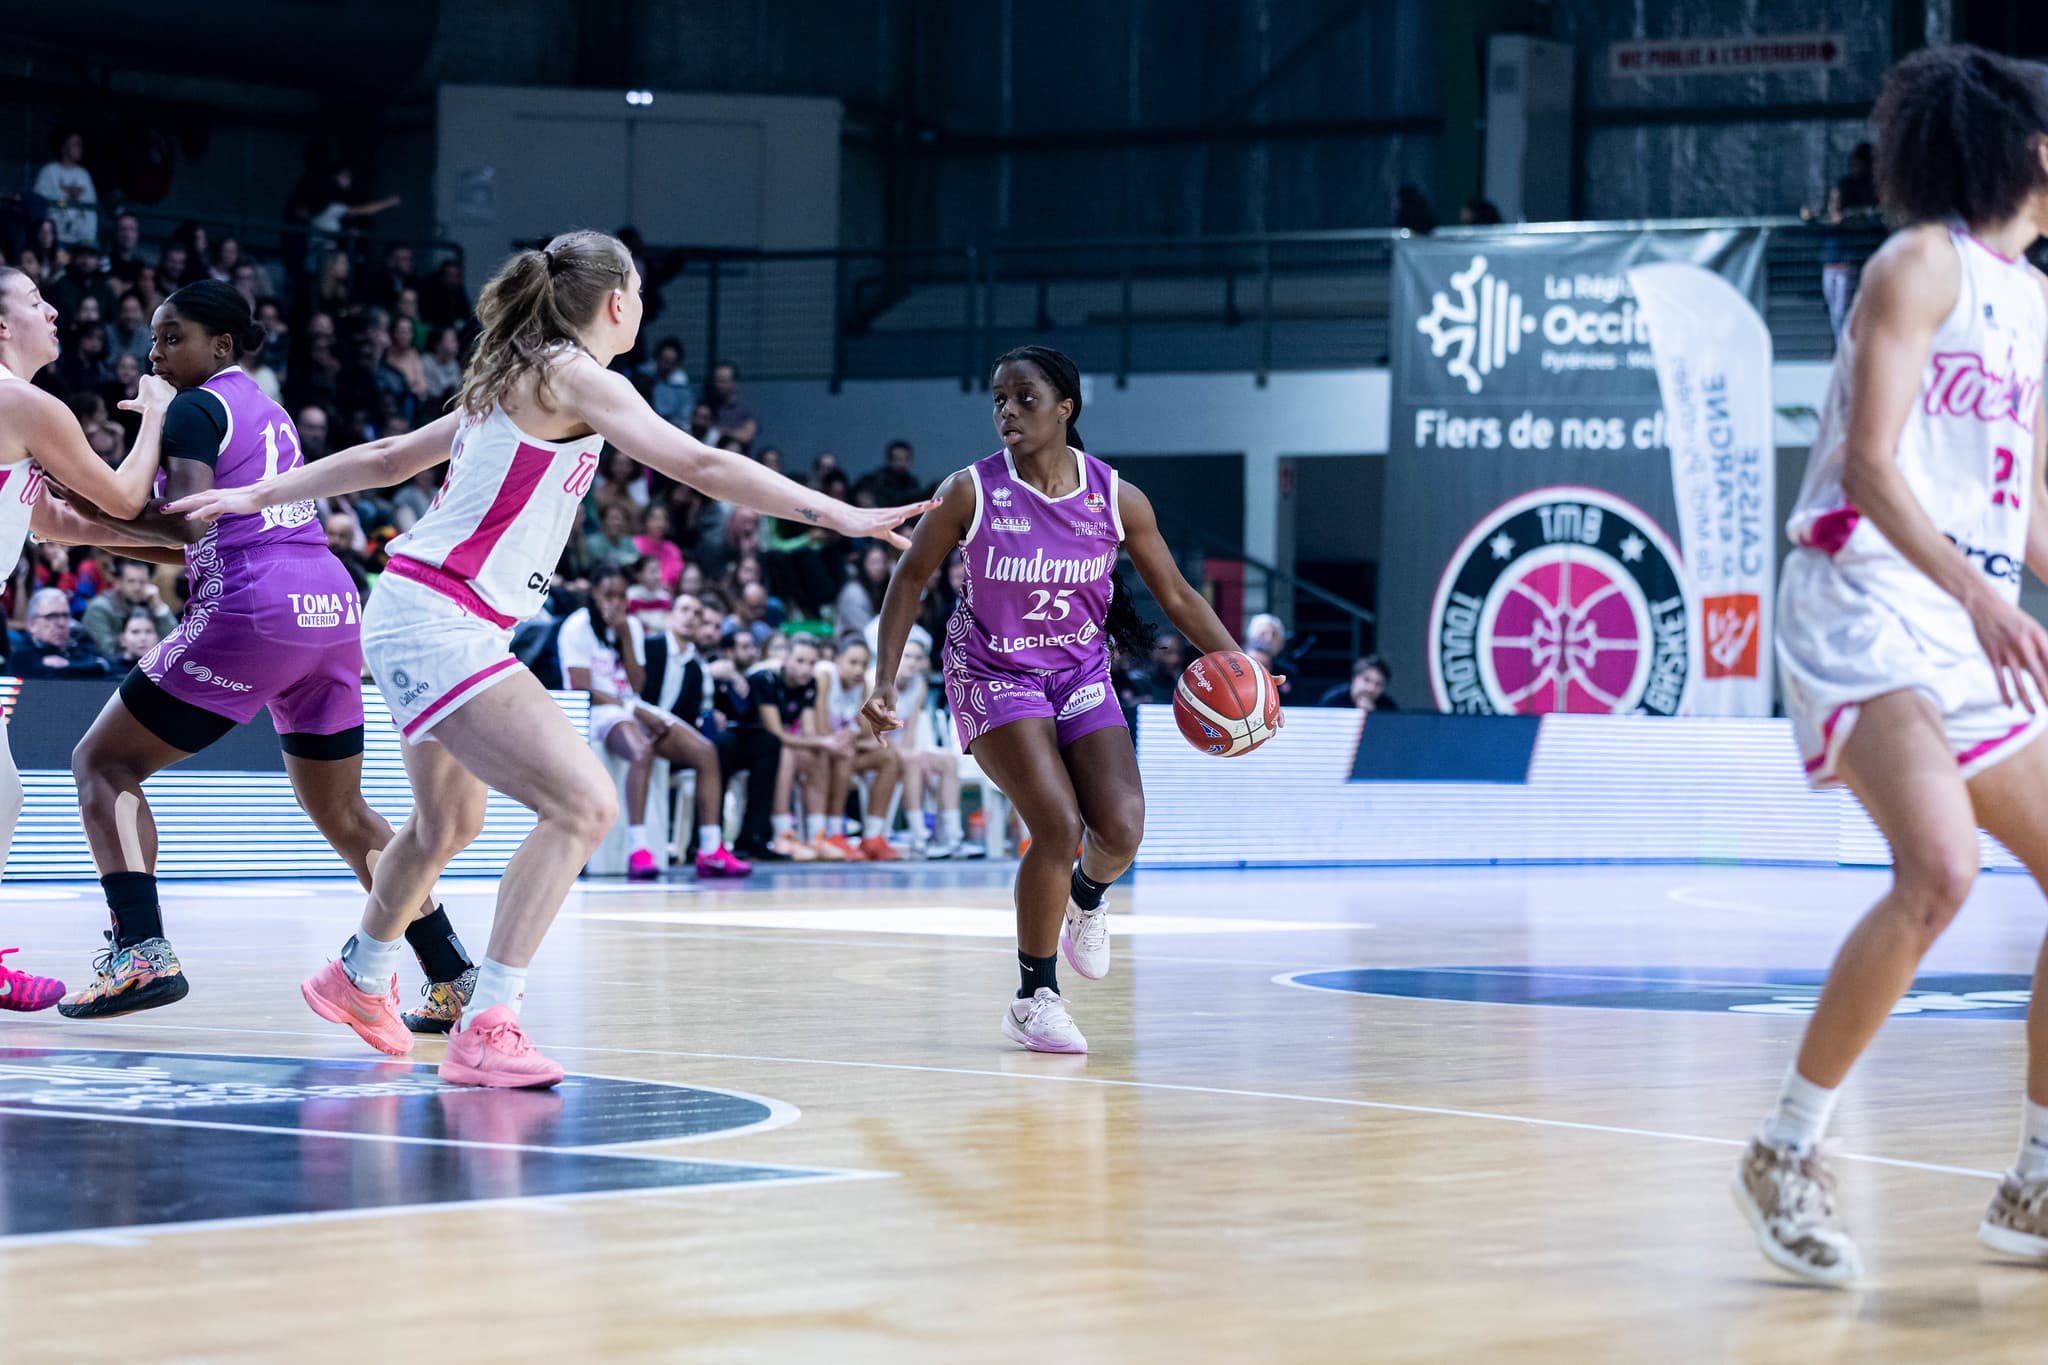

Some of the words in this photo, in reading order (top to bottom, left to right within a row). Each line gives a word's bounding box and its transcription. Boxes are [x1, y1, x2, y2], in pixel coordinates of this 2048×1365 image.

[1544, 274, 1572, 300] La
[1415, 409, 1502, 449] Fiers
[1508, 409, 1554, 450] de
[1561, 417, 1626, 450] nos
[1632, 409, 1671, 450] cl
[1536, 502, 1604, 545] TMB
[288, 593, 344, 614] TOMA
[1021, 589, 1077, 621] 25
[300, 613, 337, 626] INTERIM
[988, 633, 1076, 654] E.Leclerc
